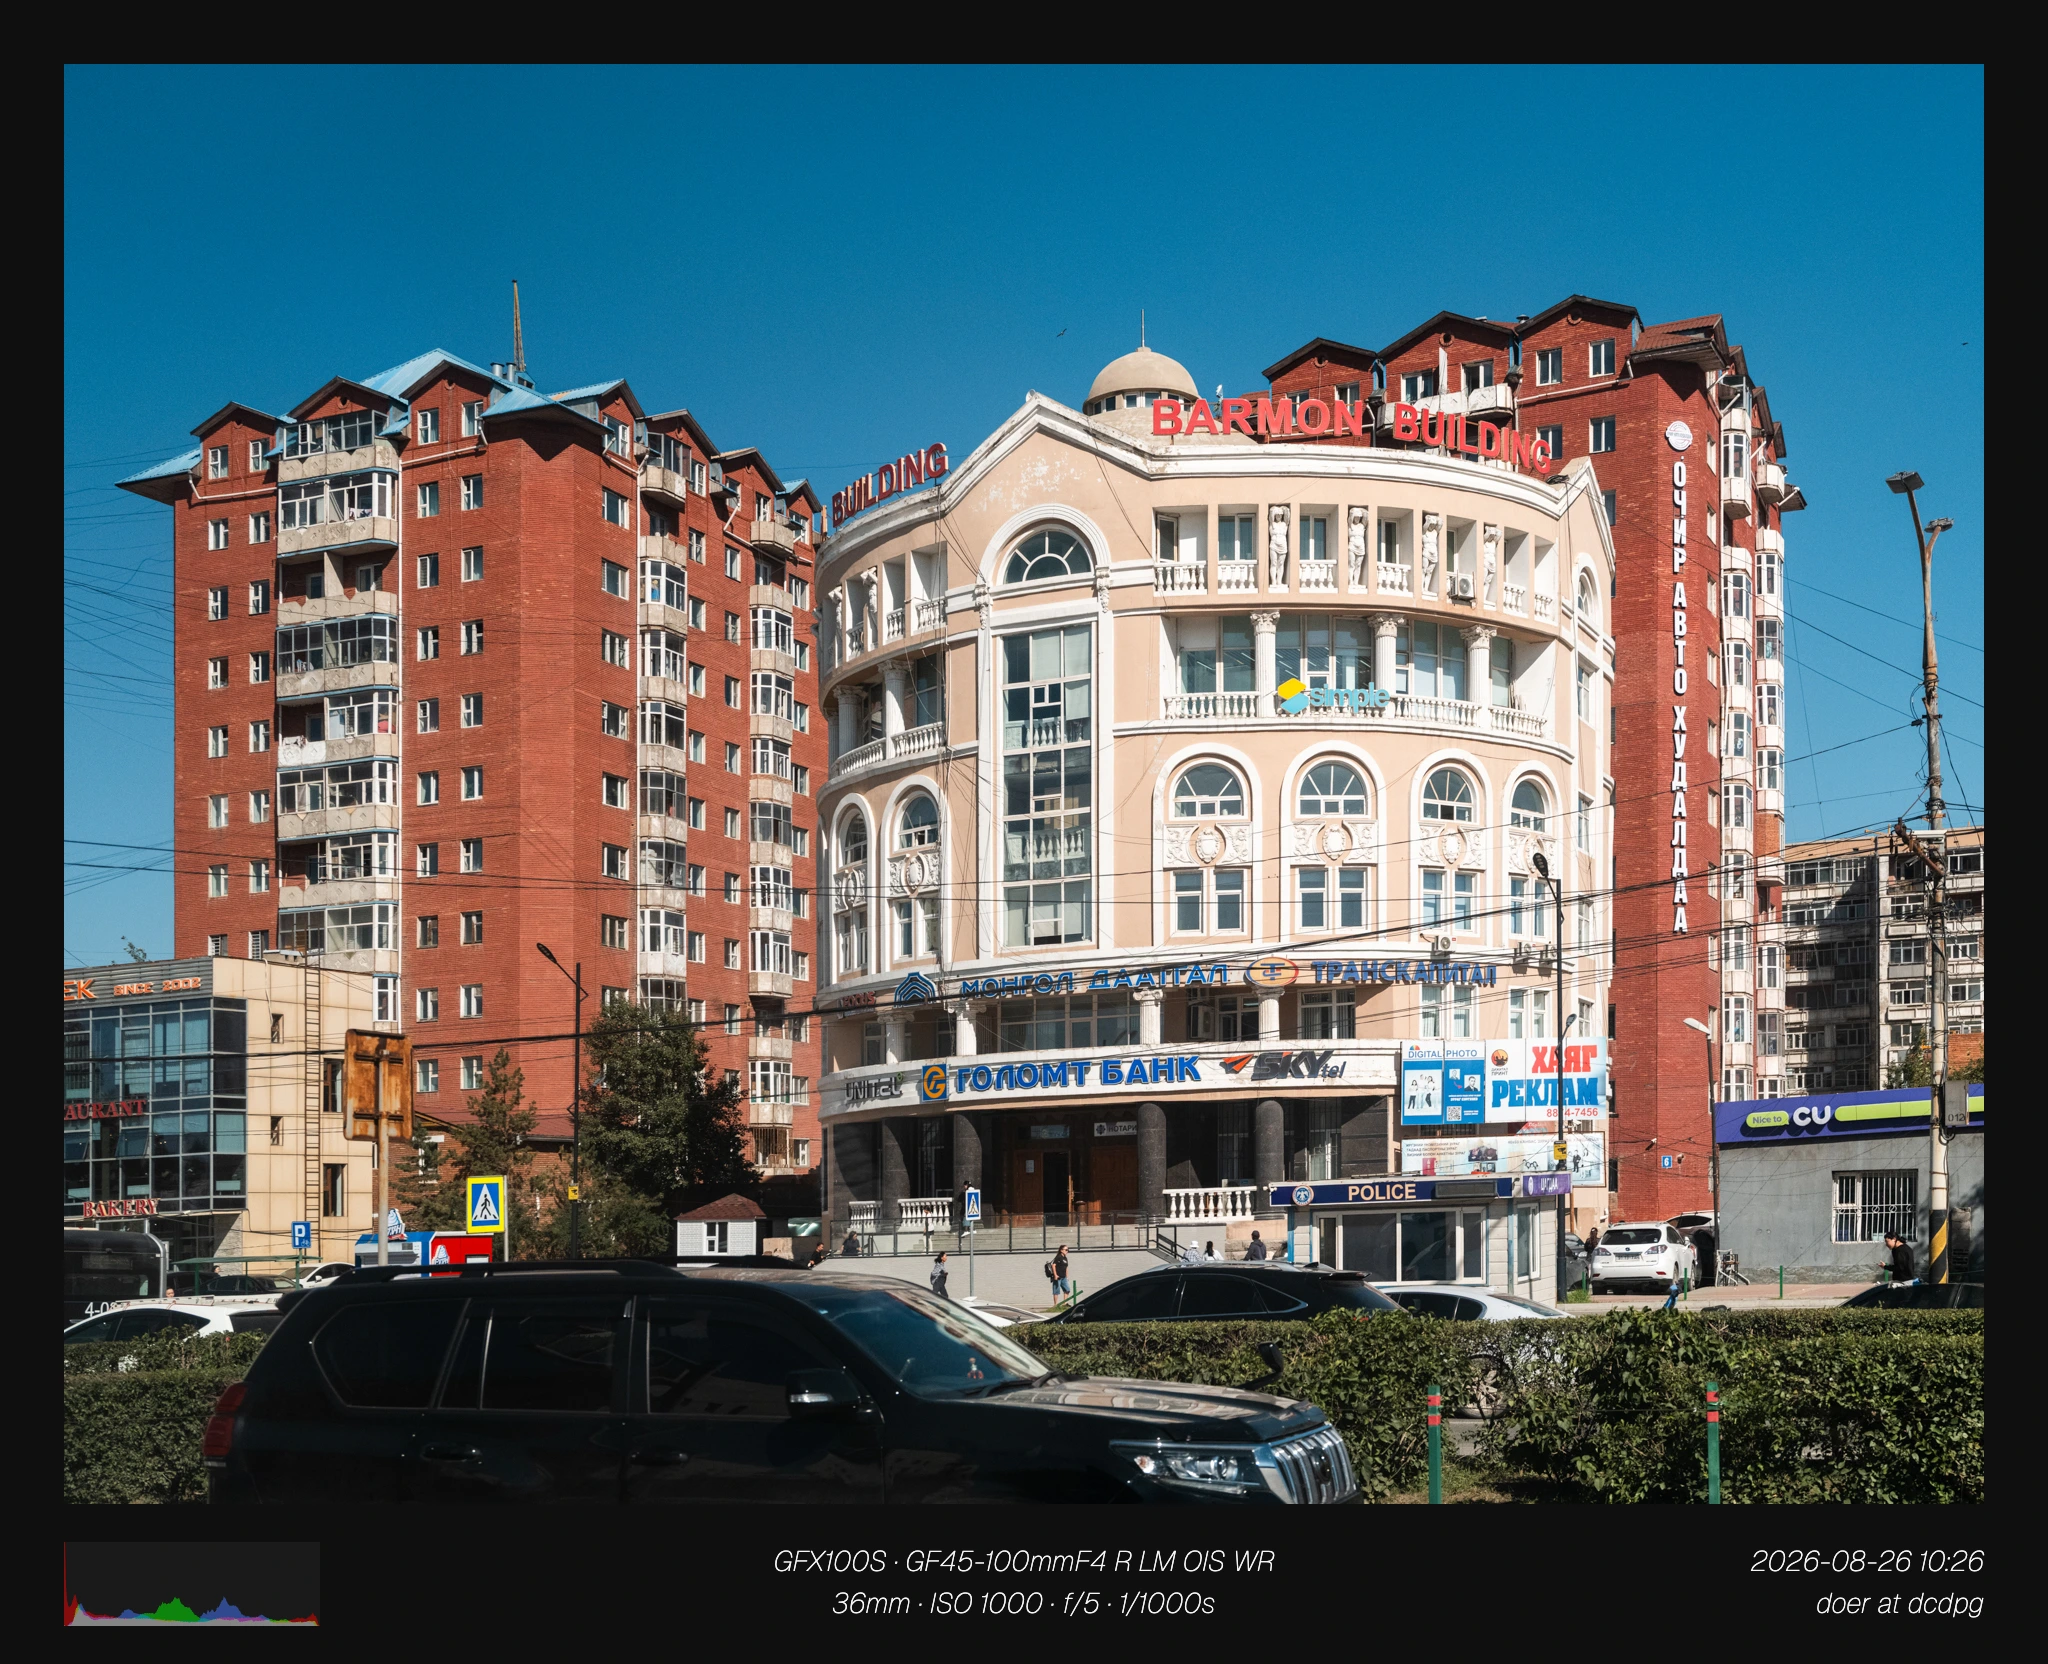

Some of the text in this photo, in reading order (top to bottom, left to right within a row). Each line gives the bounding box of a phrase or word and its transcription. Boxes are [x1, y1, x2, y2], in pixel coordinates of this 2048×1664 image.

[1153, 399, 1551, 474] BARMON BUILDING
[832, 442, 948, 528] BUILDING
[1310, 682, 1390, 714] simple
[1672, 461, 1688, 933] ОЧИР АВТО ХУДАЛДАА
[961, 964, 1229, 999] МОНГОЛ ДААТГАЛ
[1312, 959, 1497, 985] ТРАНСКАПИТАЛ
[113, 977, 201, 996] SINCE 2002
[1408, 1049, 1478, 1059] DIGITAL PHOTO
[1531, 1045, 1598, 1074] ХАЯГ
[956, 1056, 1201, 1093] ГОЛОМТ БАНК
[1492, 1077, 1599, 1108] РЕКЛАМ
[64, 1099, 146, 1120] AURANT
[1546, 1107, 1598, 1118] 884-7456
[1752, 1115, 1782, 1124] Nice to
[1792, 1105, 1831, 1126] CU
[1664, 1157, 1670, 1167] 6
[1348, 1183, 1416, 1201] POLICE
[83, 1198, 160, 1219] BAKERY
[294, 1224, 306, 1246] P
